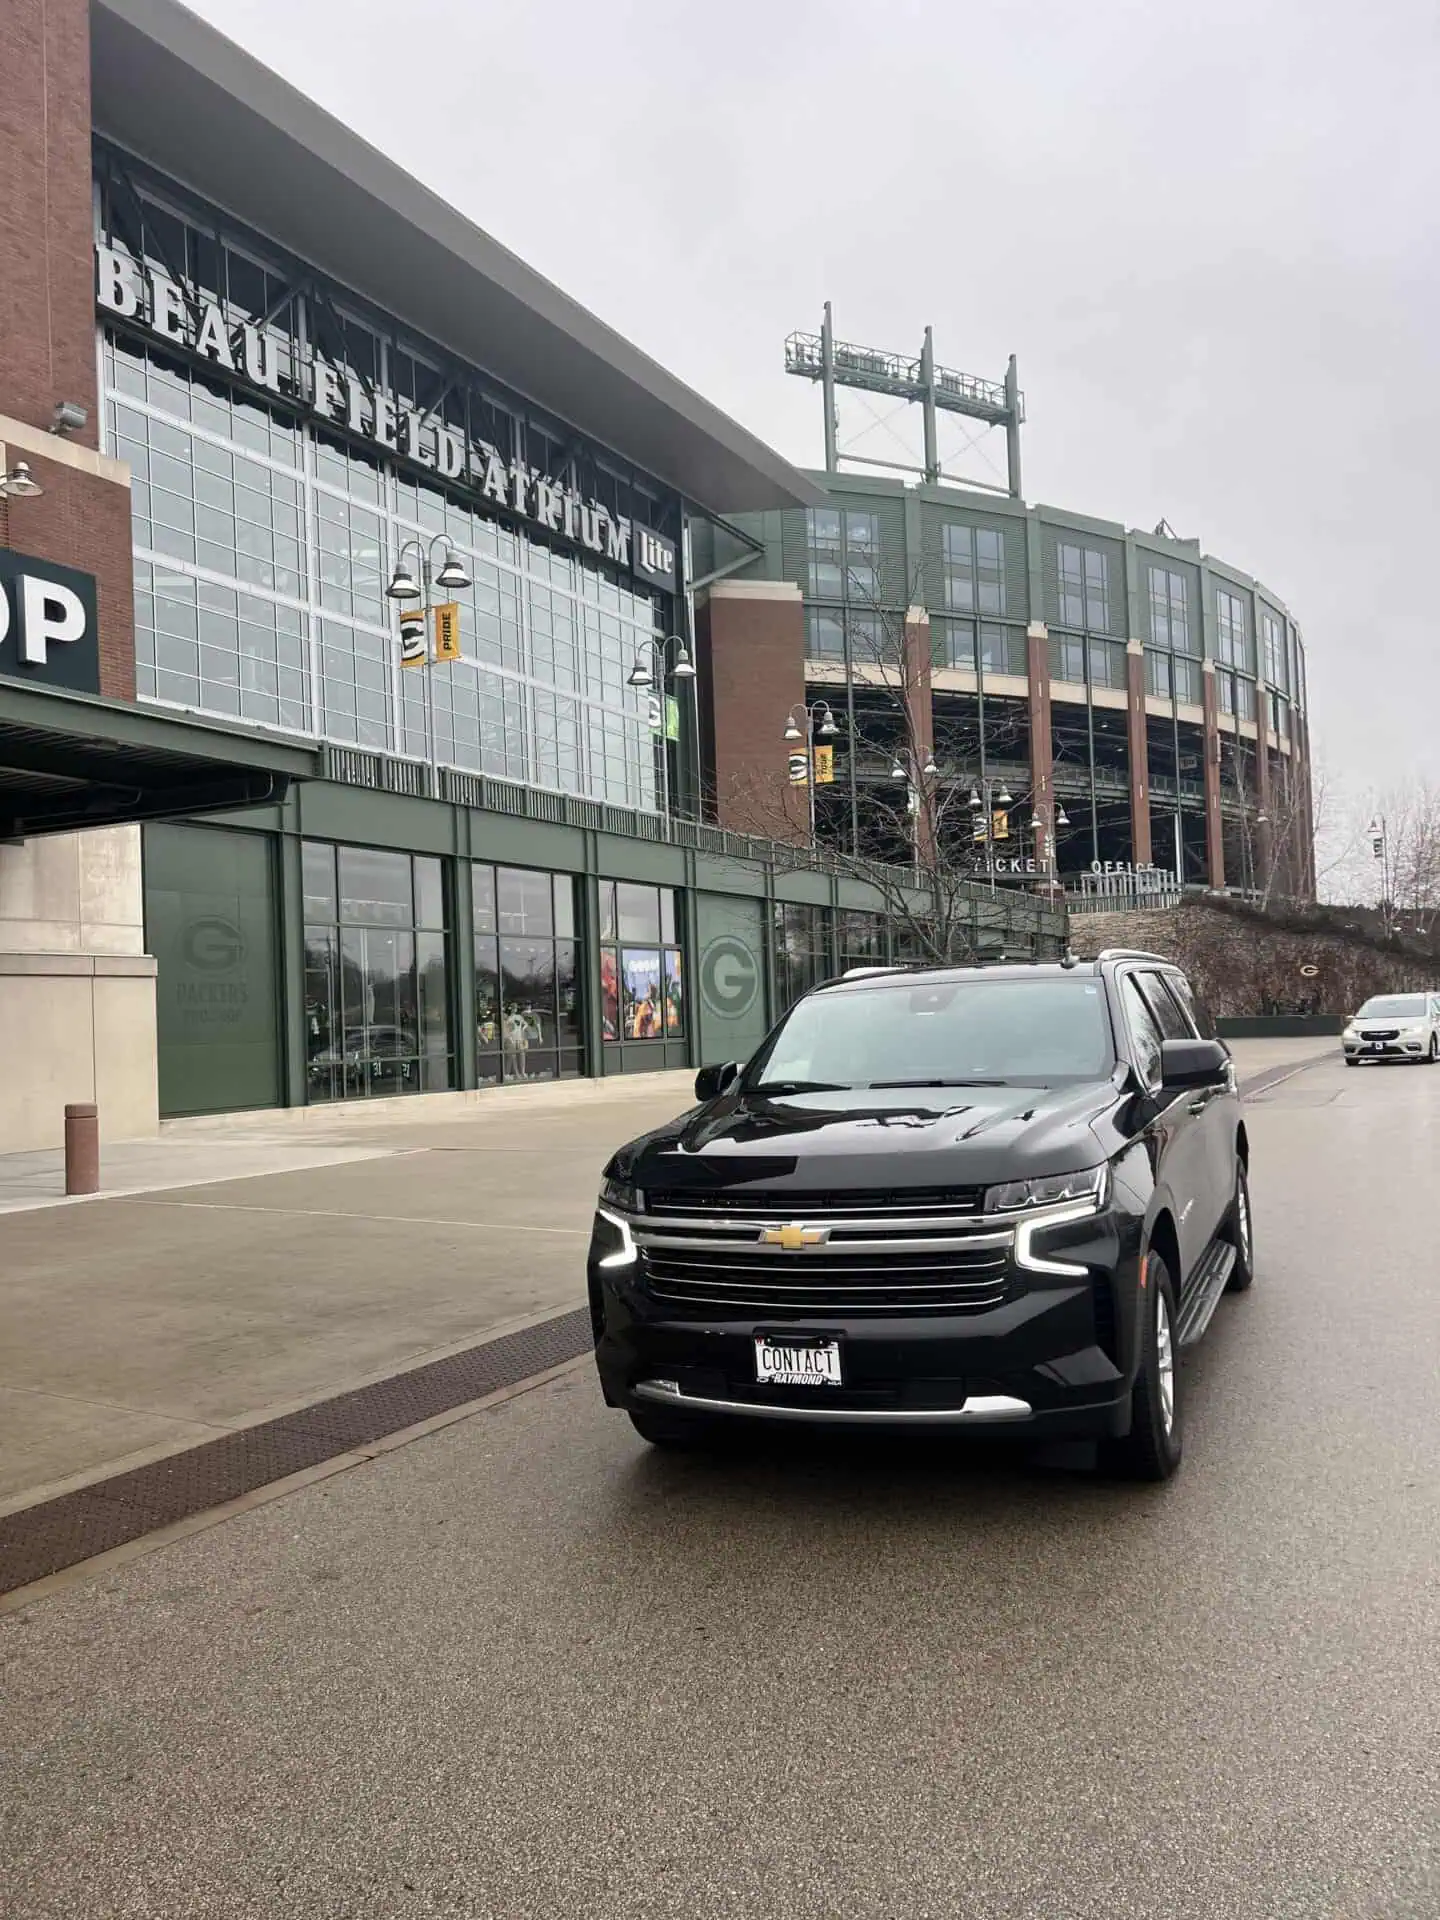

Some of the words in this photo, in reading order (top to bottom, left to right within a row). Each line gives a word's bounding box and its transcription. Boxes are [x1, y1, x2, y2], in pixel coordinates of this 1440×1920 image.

[312, 360, 465, 478] FIELD
[483, 454, 631, 567] ATRIUM
[640, 530, 673, 574] Lite
[441, 612, 452, 651] PRIDE
[973, 857, 1049, 873] TICKET
[702, 942, 757, 1013] G
[762, 1347, 833, 1374] CONTACT
[773, 1373, 824, 1385] RAYMOND
